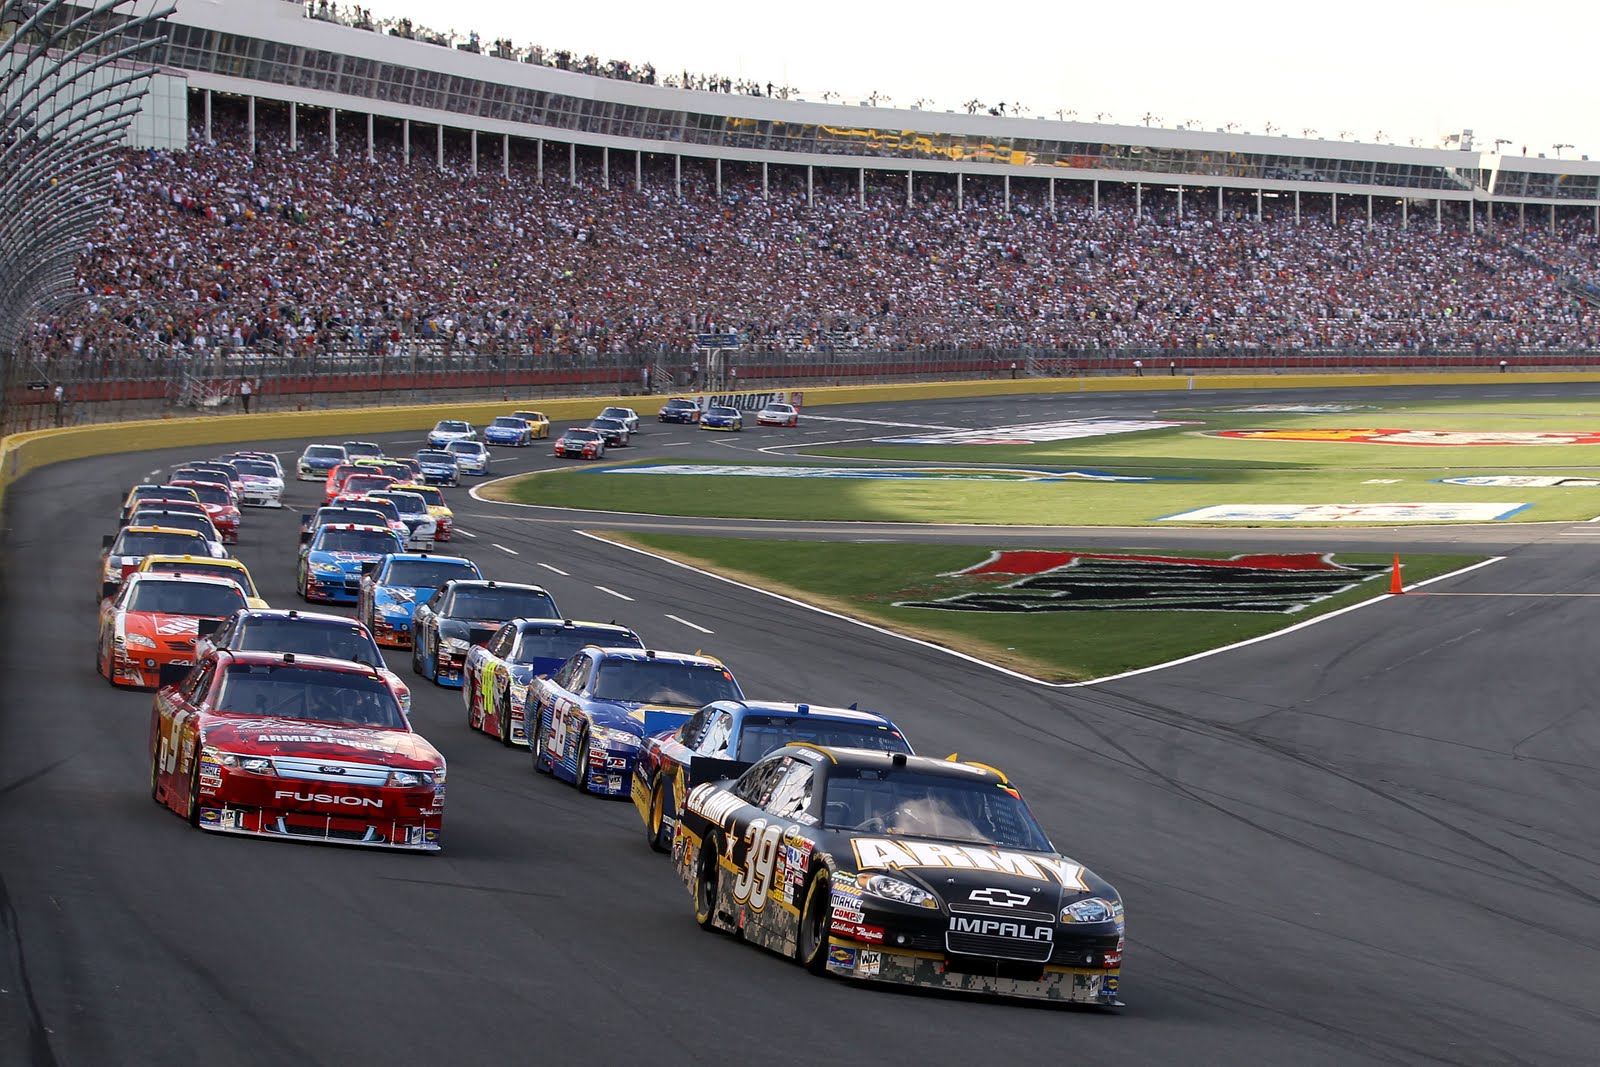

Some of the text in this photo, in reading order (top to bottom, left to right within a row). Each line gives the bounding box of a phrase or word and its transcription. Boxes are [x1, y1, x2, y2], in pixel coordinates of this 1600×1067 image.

[708, 393, 776, 411] CHARLOTTE
[614, 731, 633, 742] 56
[258, 735, 396, 755] ARMED FORCES
[275, 791, 383, 808] FUSION
[733, 818, 783, 912] 39
[851, 838, 1090, 893] ARMY
[833, 882, 863, 896] MOOG
[881, 880, 909, 896] 39
[831, 894, 862, 909] MAHLE
[834, 908, 856, 920] COMP
[950, 917, 1053, 941] IMPALA
[861, 953, 879, 965] WIX
